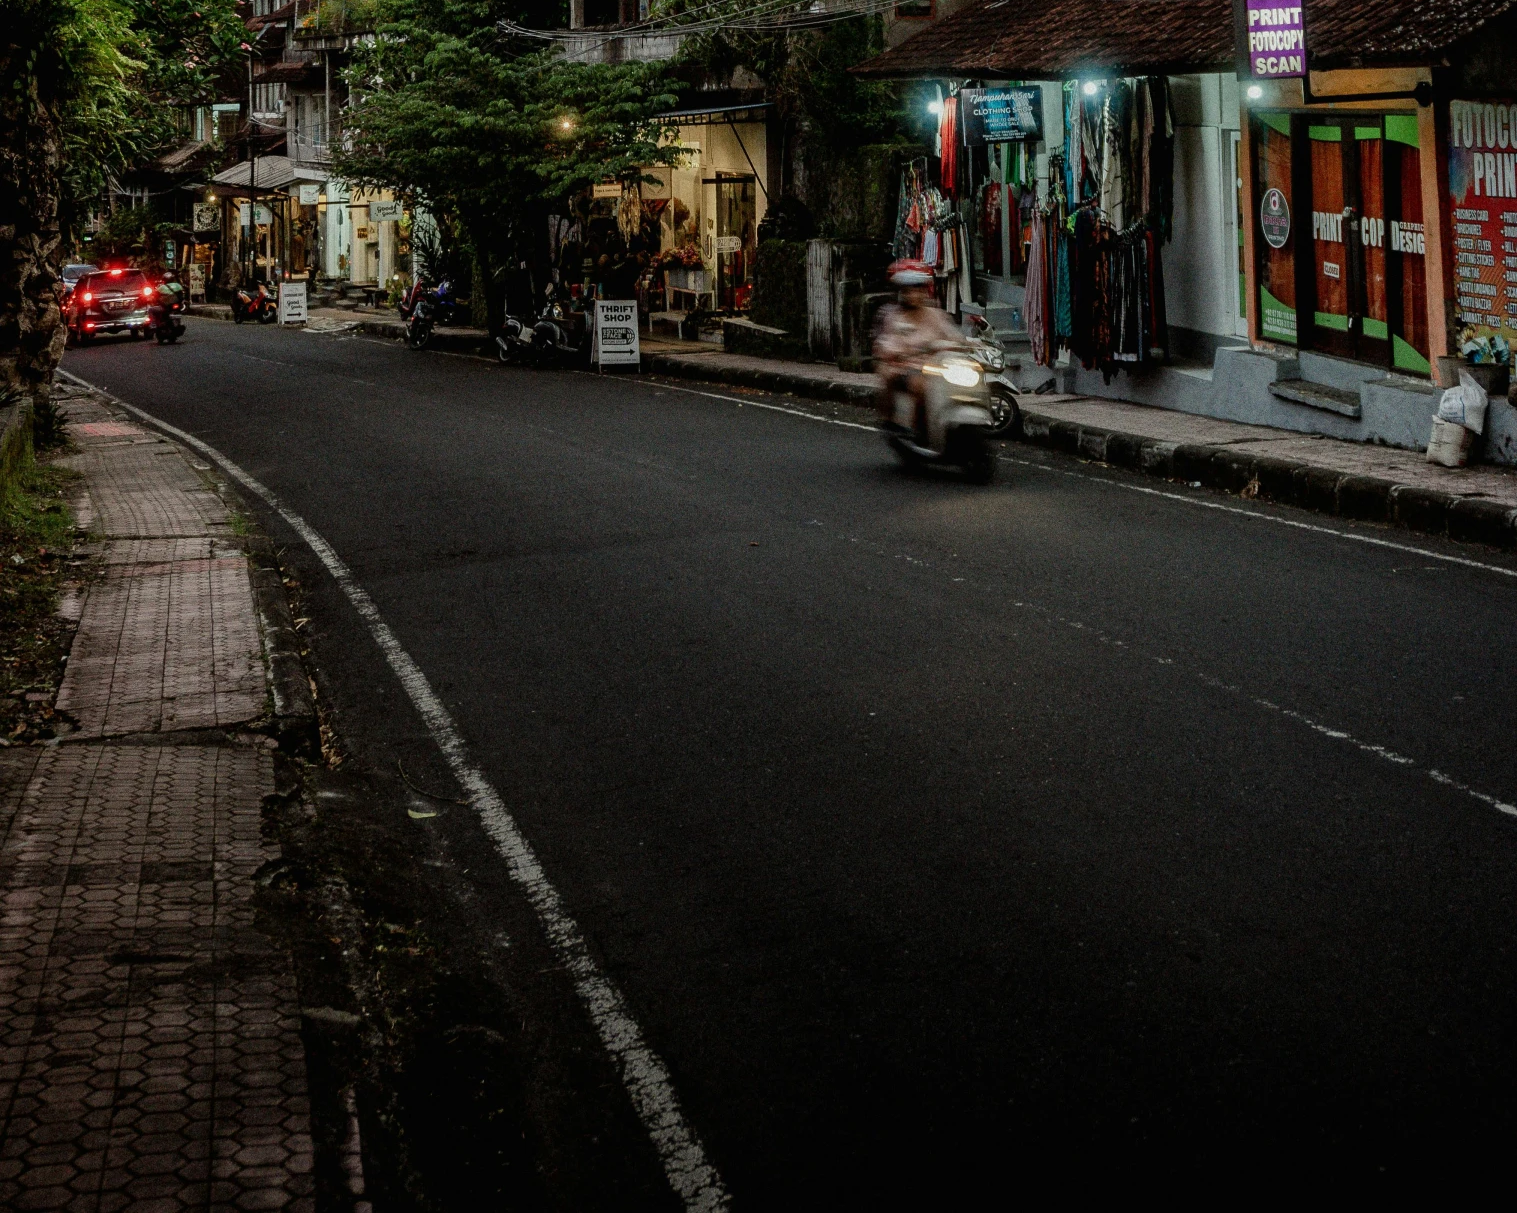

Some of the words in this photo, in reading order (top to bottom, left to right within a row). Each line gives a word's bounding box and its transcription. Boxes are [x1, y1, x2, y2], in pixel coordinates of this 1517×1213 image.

[1249, 7, 1302, 26] PRINT
[1249, 29, 1304, 52] FOTOCOPY
[1256, 55, 1302, 74] SCAN
[973, 107, 1011, 116] CLOTHING
[1312, 211, 1343, 243] PRINT
[1361, 216, 1385, 248] COP
[600, 305, 634, 313] THRIFT
[604, 314, 632, 322] SHOP
